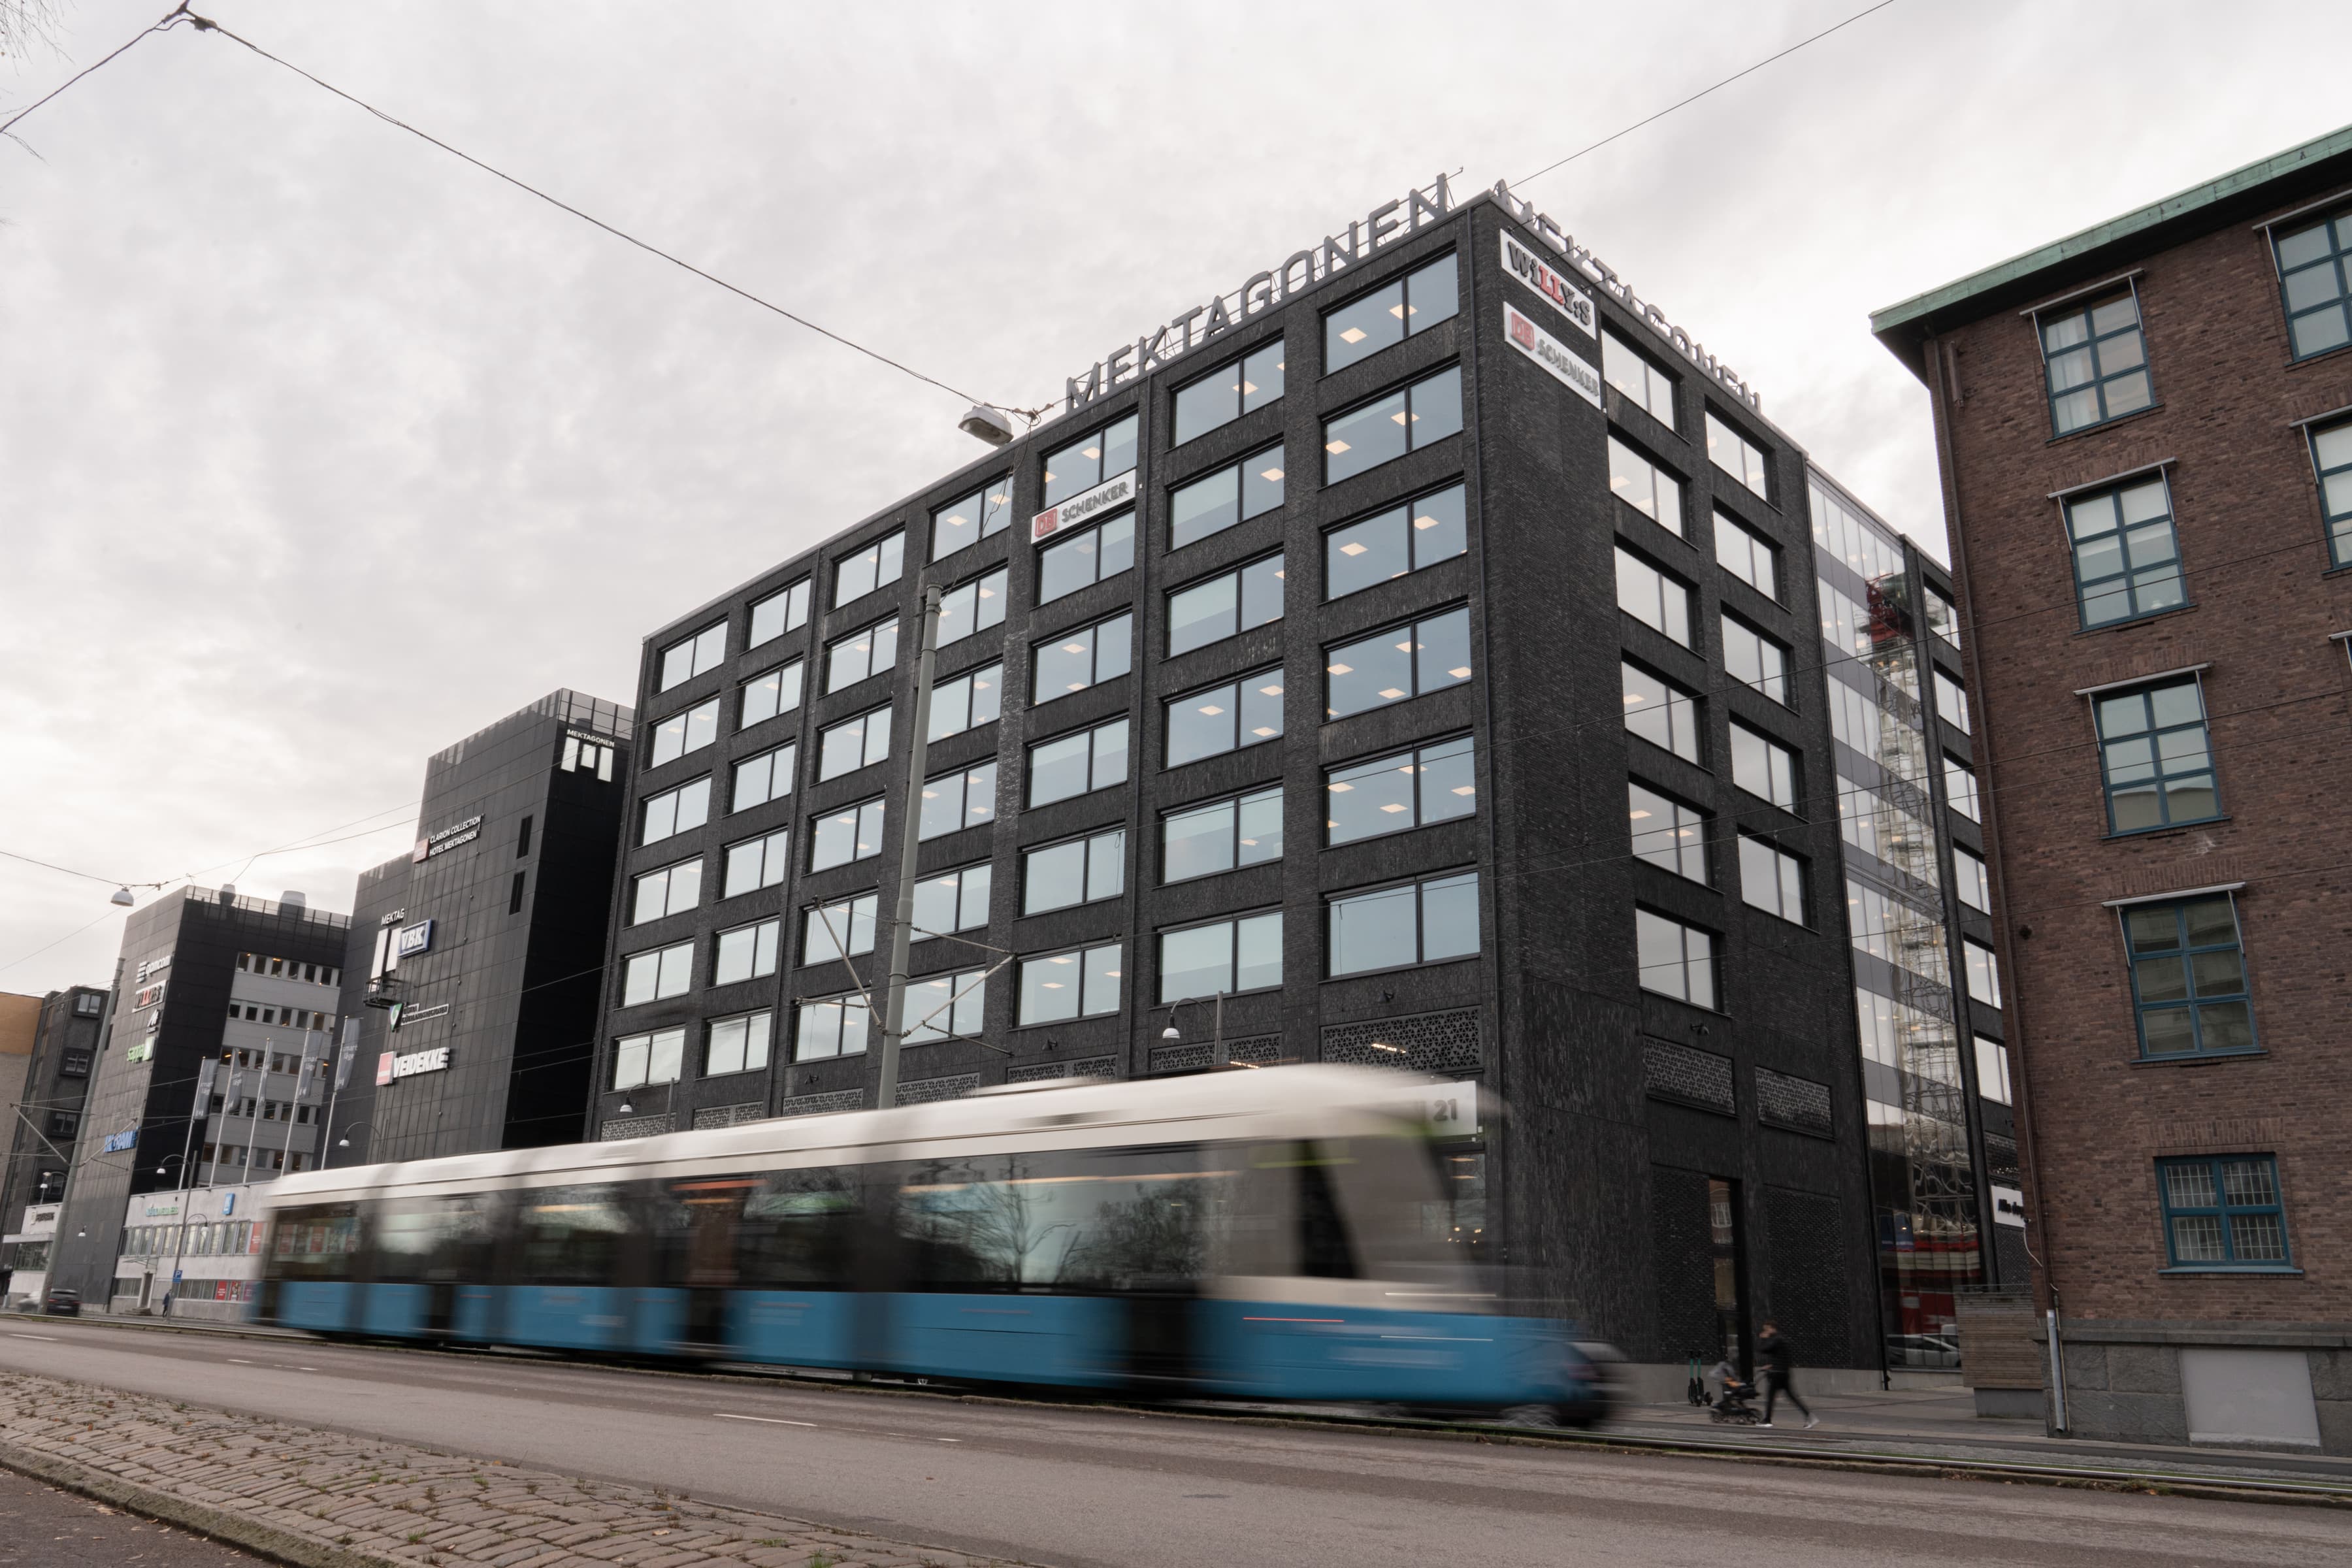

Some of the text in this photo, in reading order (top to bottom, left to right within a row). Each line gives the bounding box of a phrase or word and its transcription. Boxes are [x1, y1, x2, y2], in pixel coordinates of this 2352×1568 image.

[1066, 172, 1448, 416] MEKTAGONEN
[1512, 315, 1599, 397] DB SCHENKER
[1036, 482, 1129, 535] DB SCHENKER
[566, 728, 615, 747] MEKTAGONEN
[429, 844, 445, 857] HOTEL
[444, 830, 478, 850] MEKTAGONEN
[430, 815, 482, 844] CLARION COLLECTION
[381, 907, 405, 925] MEKTAG
[401, 926, 425, 951] VBK
[393, 1047, 449, 1078] VEIDEKKE
[1433, 1098, 1458, 1121] 21
